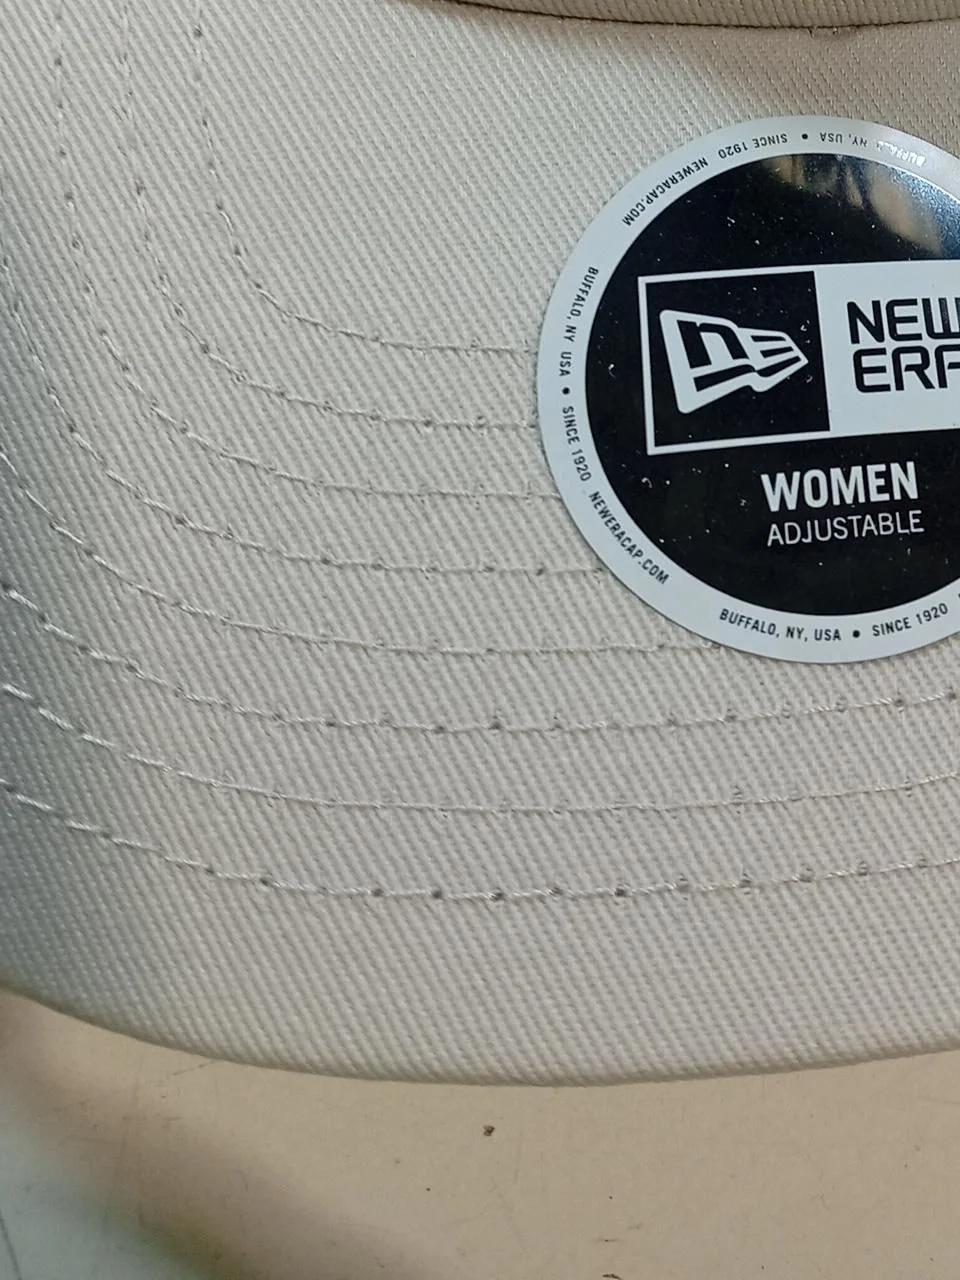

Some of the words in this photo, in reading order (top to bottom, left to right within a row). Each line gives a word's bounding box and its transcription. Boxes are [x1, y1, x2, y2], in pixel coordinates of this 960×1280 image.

[718, 141, 748, 160] 1920
[752, 133, 788, 149] SINCE
[819, 132, 843, 144] USA
[622, 157, 709, 226] NEWERACAP.COM
[566, 266, 599, 320] BUFFALO,
[558, 351, 572, 378] USA
[562, 406, 580, 446] SINCE
[571, 449, 592, 482] 1920
[760, 461, 919, 513] WOMEN
[589, 491, 670, 585] NEWERACAP.COM
[766, 509, 925, 547] ADJUSTABLE
[719, 608, 780, 638] BUFFALO,
[786, 626, 808, 642] NY,
[814, 628, 841, 641] USA
[871, 616, 911, 637] SINCE
[915, 602, 949, 625] 1920
